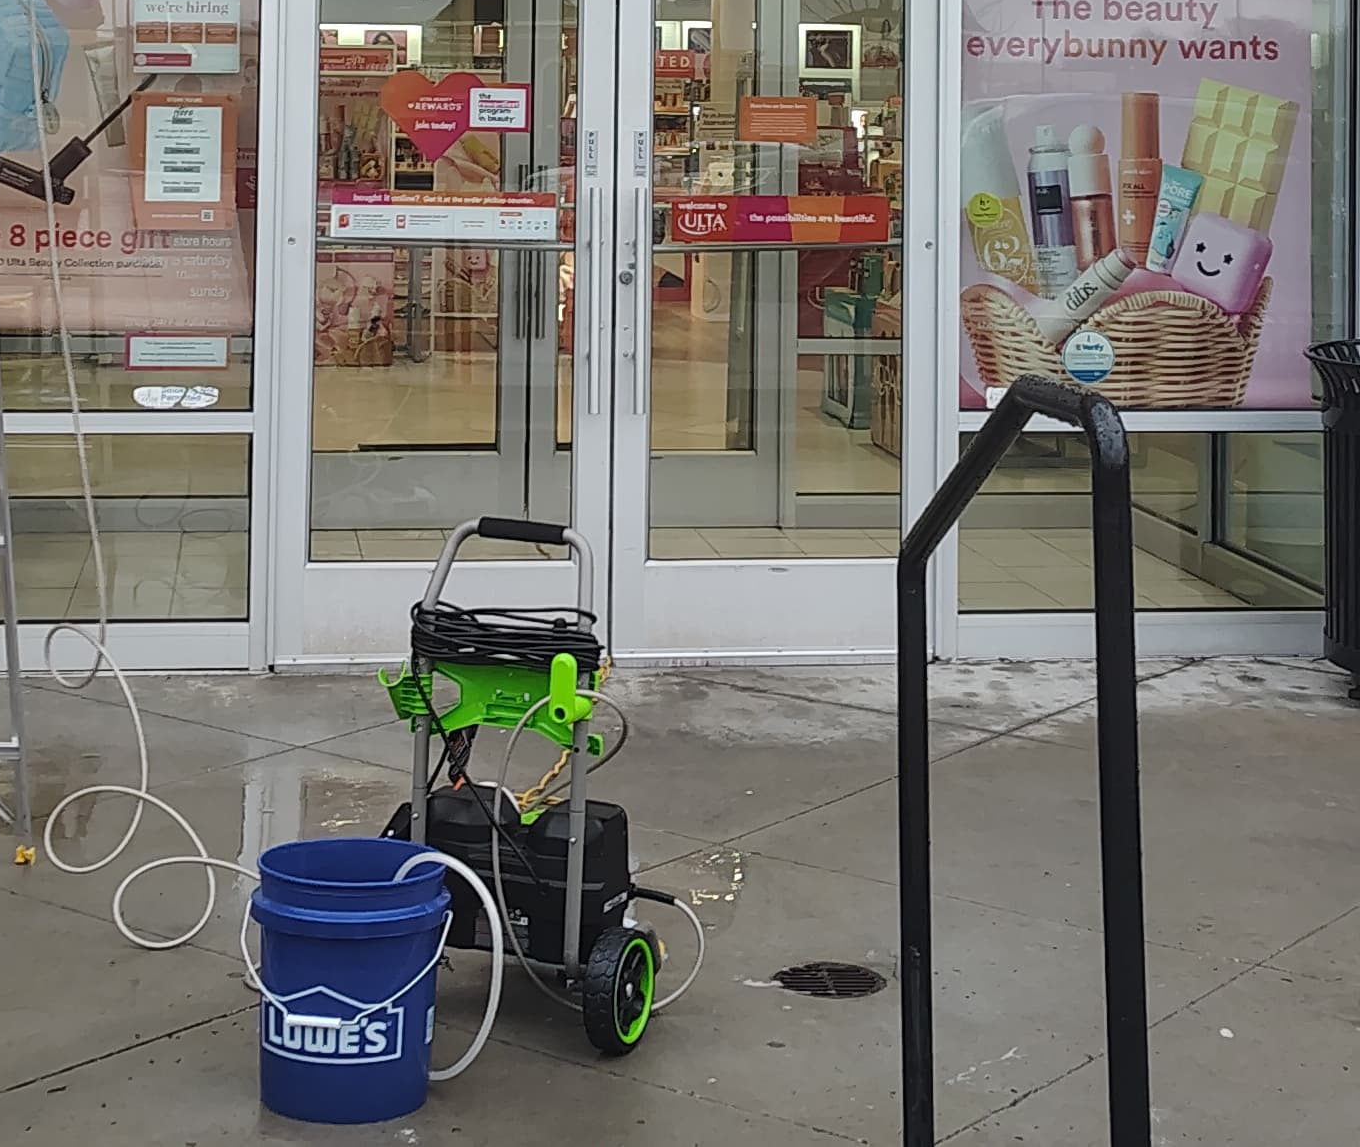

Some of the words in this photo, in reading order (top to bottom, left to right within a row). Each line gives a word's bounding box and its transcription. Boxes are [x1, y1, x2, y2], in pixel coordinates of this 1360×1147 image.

[145, 1, 183, 14] we're
[186, 0, 230, 16] hiring
[966, 29, 1168, 67] everybunny
[1178, 34, 1280, 61] wants
[414, 103, 462, 111] REWARDS
[678, 201, 717, 210] welcome
[684, 213, 724, 229] ULTA
[749, 213, 763, 223] the
[766, 213, 817, 224] possibilities
[9, 224, 26, 247] 8
[35, 222, 113, 254] piece
[29, 257, 62, 269] Beauy
[64, 257, 114, 268] Collection
[268, 1006, 389, 1055] LOWE'S
